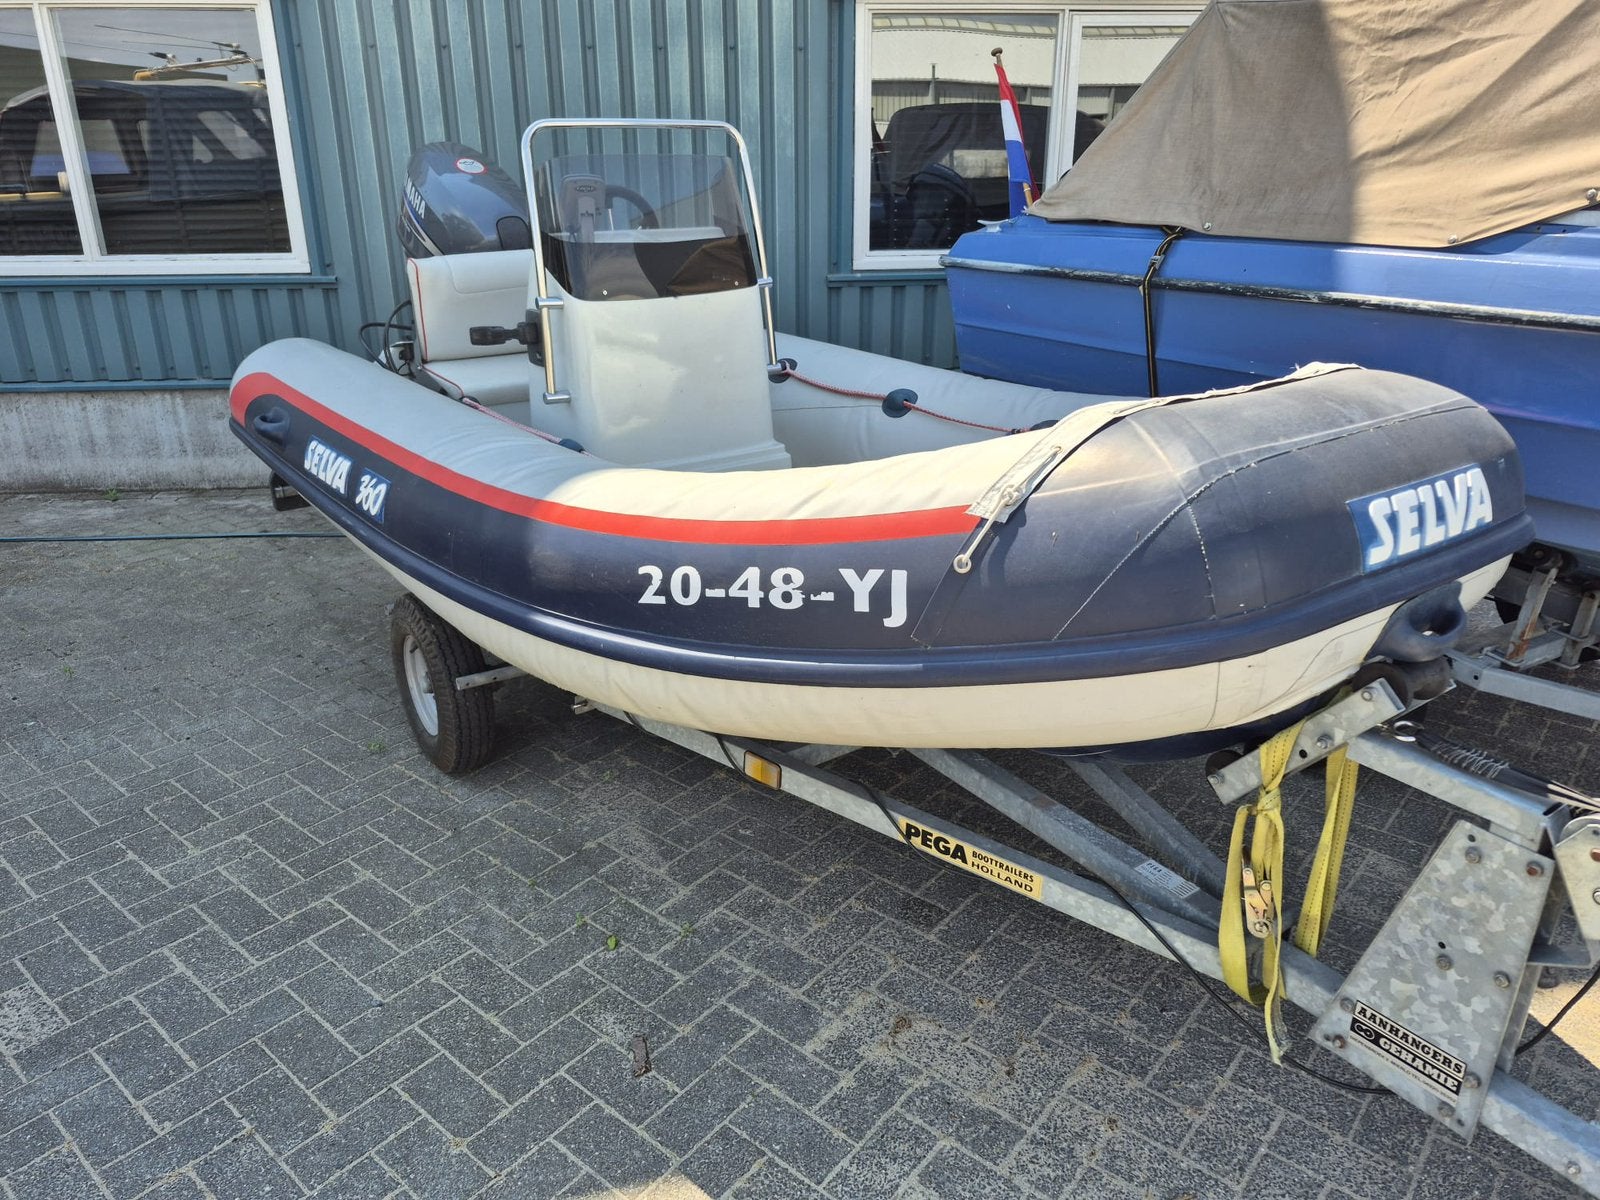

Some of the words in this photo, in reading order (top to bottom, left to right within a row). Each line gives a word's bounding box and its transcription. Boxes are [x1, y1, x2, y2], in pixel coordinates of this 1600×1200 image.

[303, 440, 352, 495] SELVA
[355, 474, 387, 516] 360
[1367, 467, 1493, 566] SELVA
[637, 565, 908, 628] 20-48-YJ
[905, 822, 968, 865] PEGA
[971, 850, 1034, 883] BOOTTRAILERS
[971, 860, 1034, 893] HOLLAND
[1356, 1006, 1462, 1075] AANHANGERS
[1378, 1036, 1459, 1092] GEHAMIE
